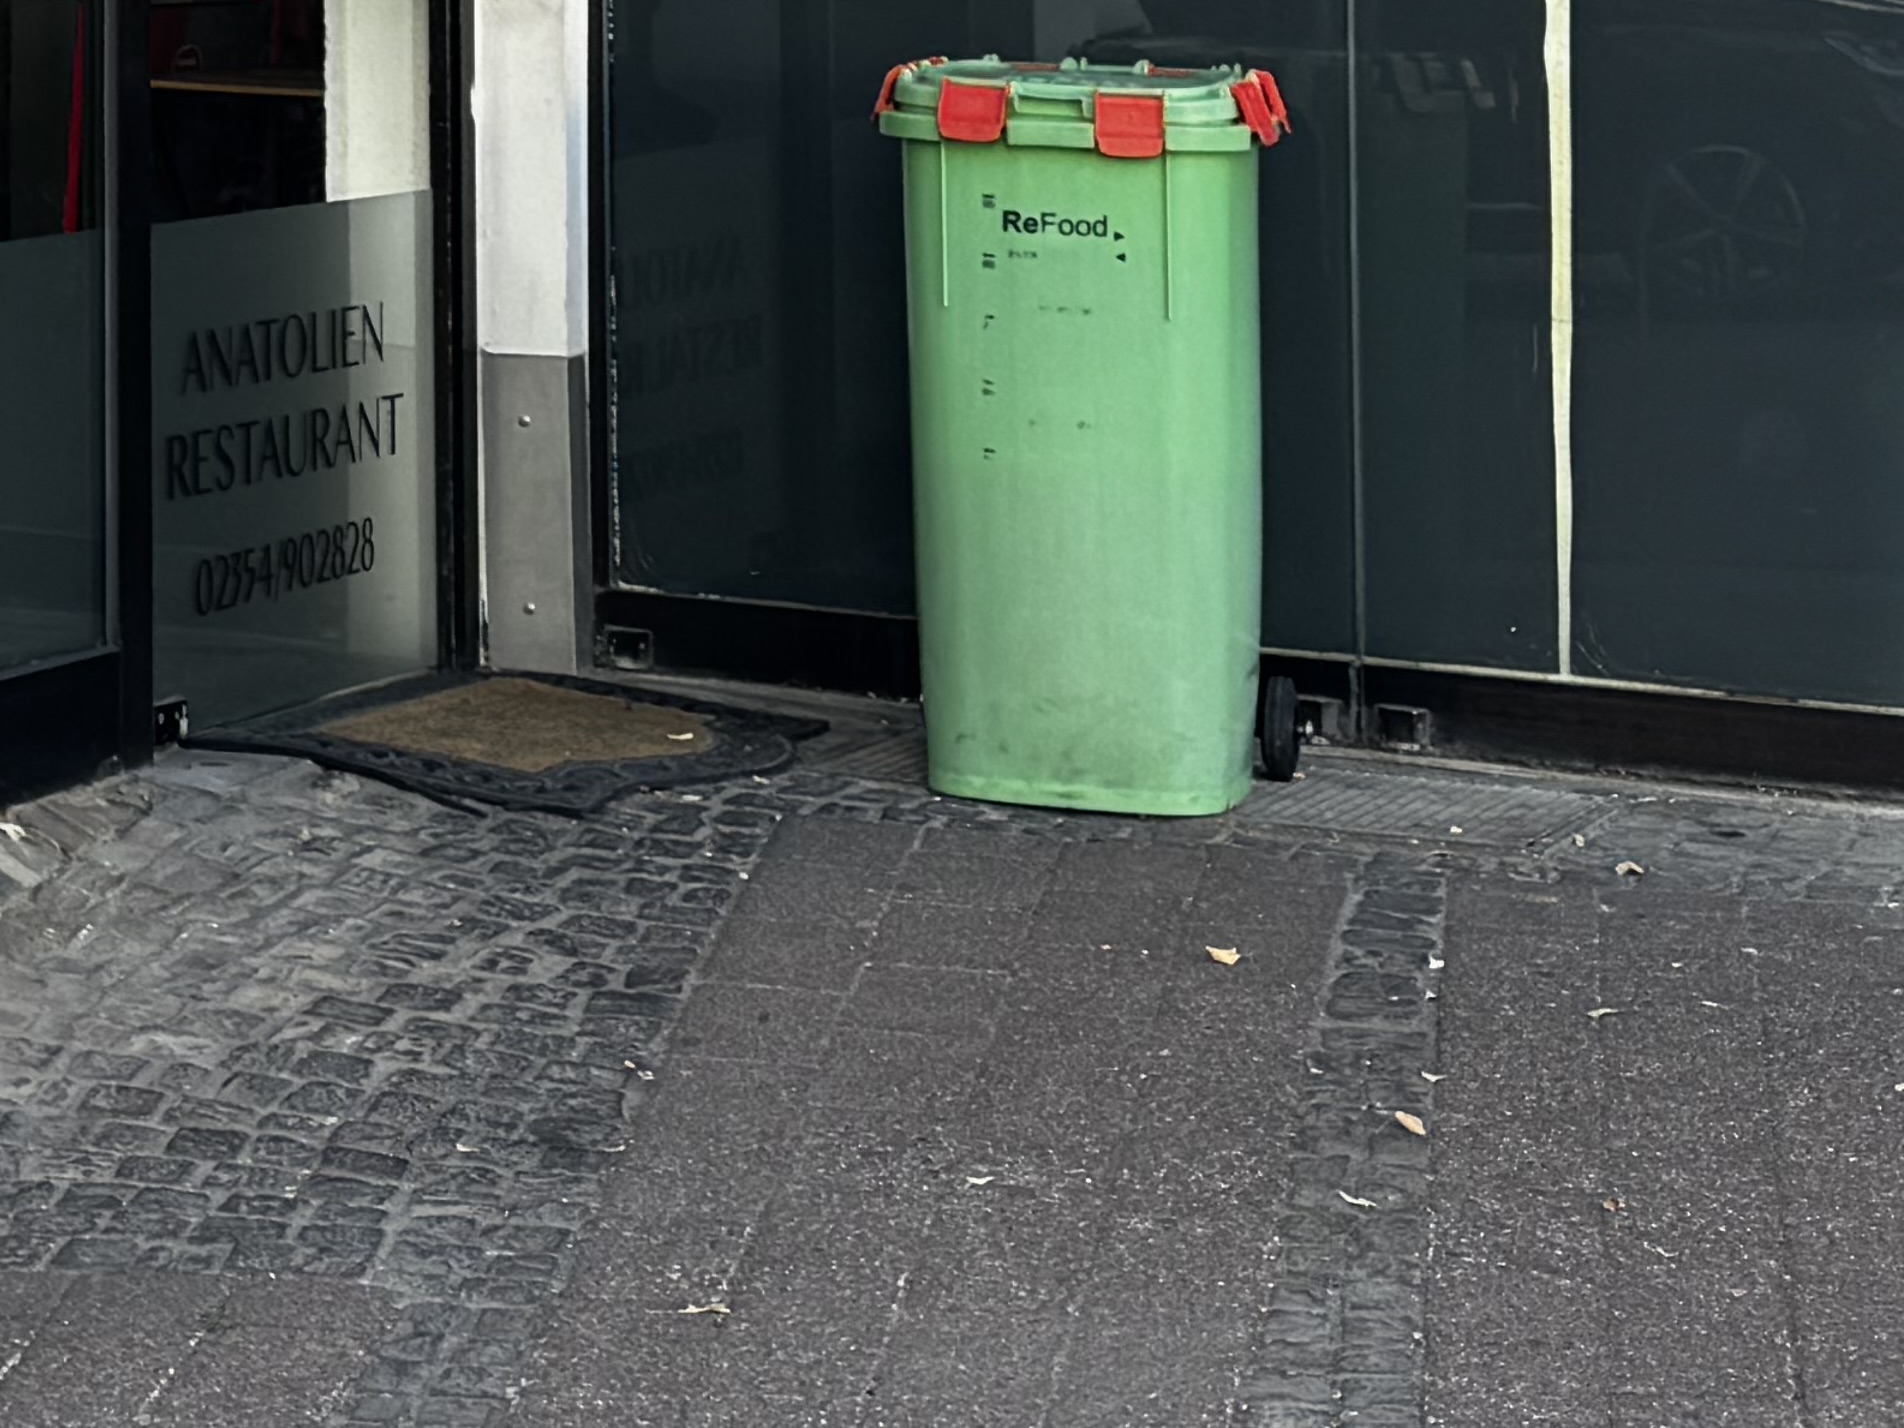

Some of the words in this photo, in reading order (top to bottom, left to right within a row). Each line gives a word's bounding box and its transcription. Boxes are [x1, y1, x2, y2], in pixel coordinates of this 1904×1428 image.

[1001, 209, 1109, 238] ReFood
[178, 301, 386, 397] ANATOLIEN
[166, 393, 404, 502] RESTAURANT
[194, 517, 376, 616] 02354/902828
